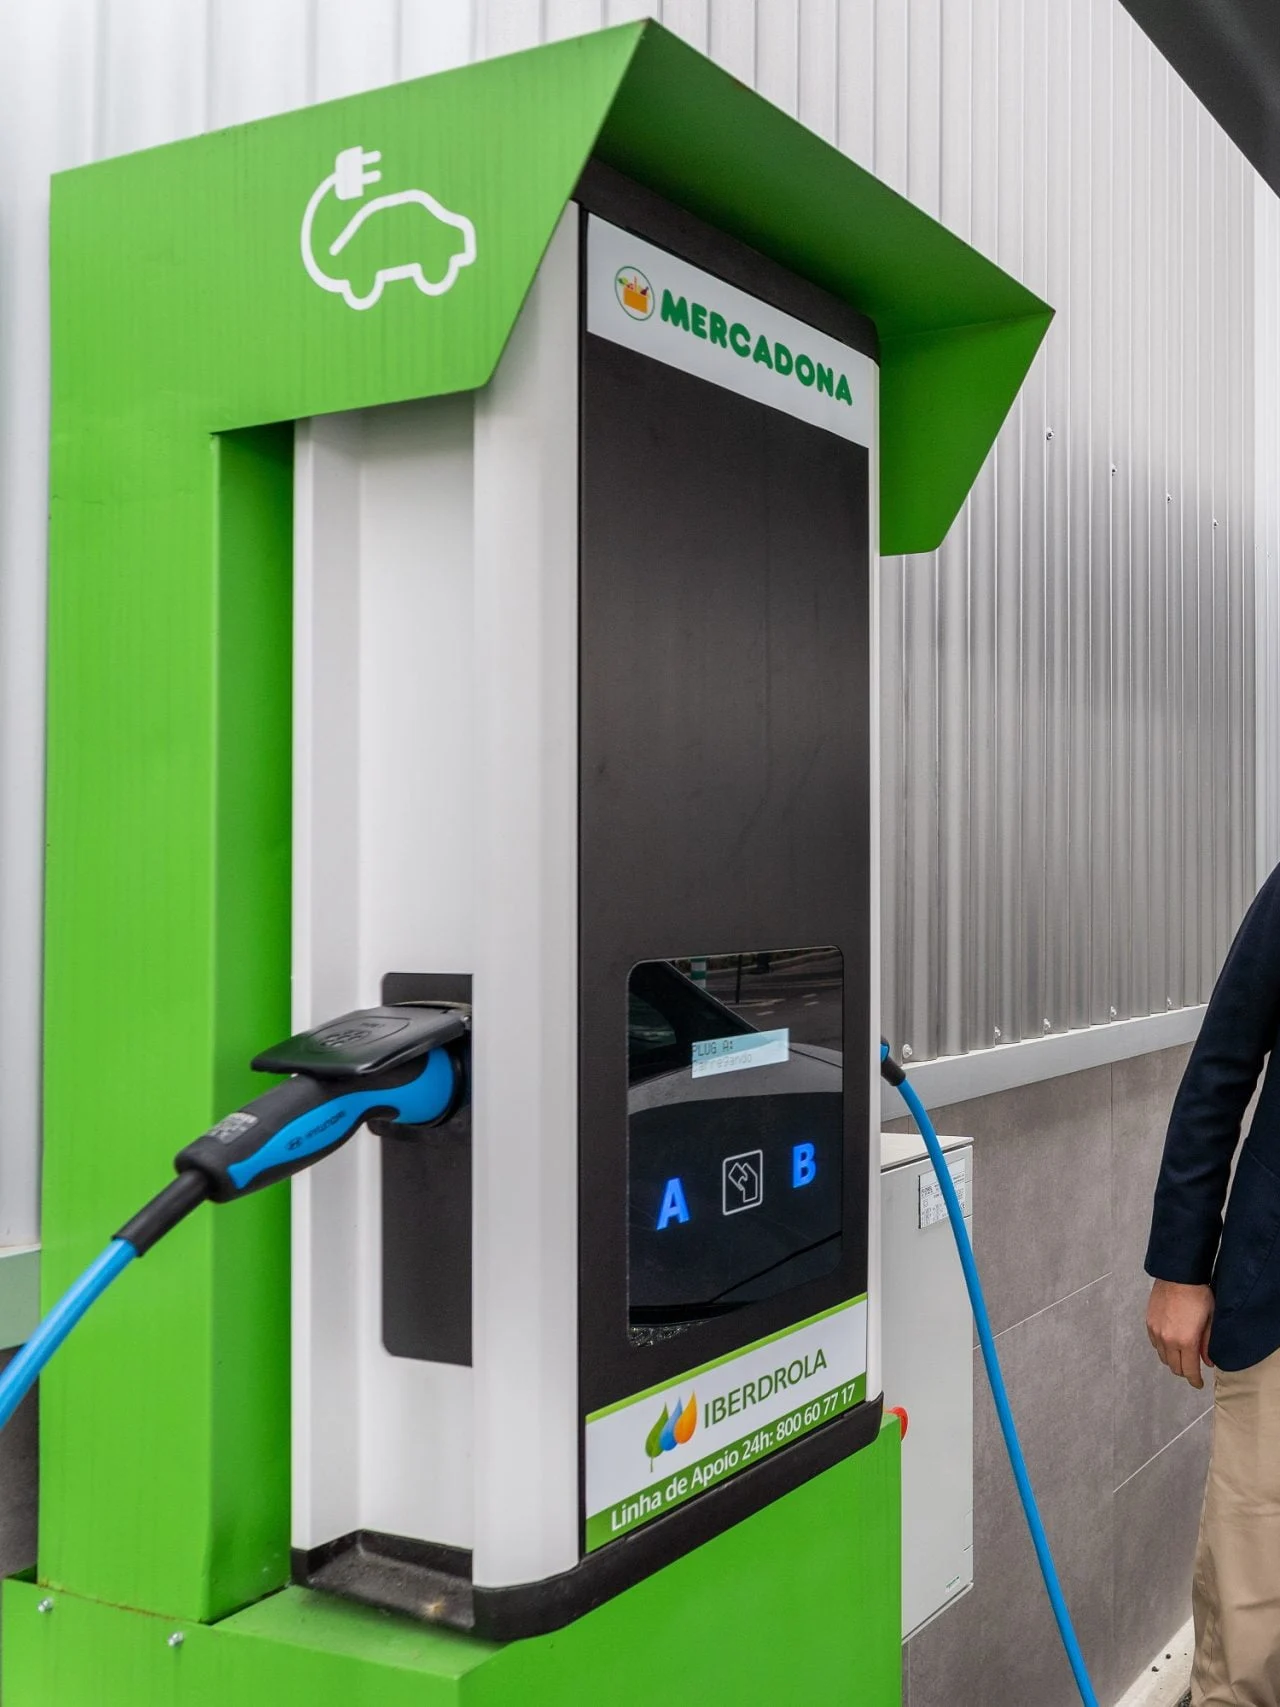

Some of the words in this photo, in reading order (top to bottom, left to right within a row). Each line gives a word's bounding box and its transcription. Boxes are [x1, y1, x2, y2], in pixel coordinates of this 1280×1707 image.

[661, 289, 853, 406] MERCADONA
[656, 1177, 691, 1231] A
[792, 1142, 817, 1189] B
[704, 1349, 827, 1428] IBERDROLA
[611, 1492, 661, 1532] Linha
[666, 1476, 687, 1499] de
[691, 1450, 738, 1489] Apoio
[742, 1432, 773, 1460] 24h:
[776, 1415, 801, 1441] 800
[804, 1402, 820, 1424] 60
[823, 1392, 839, 1414] 77
[842, 1383, 855, 1405] 17
